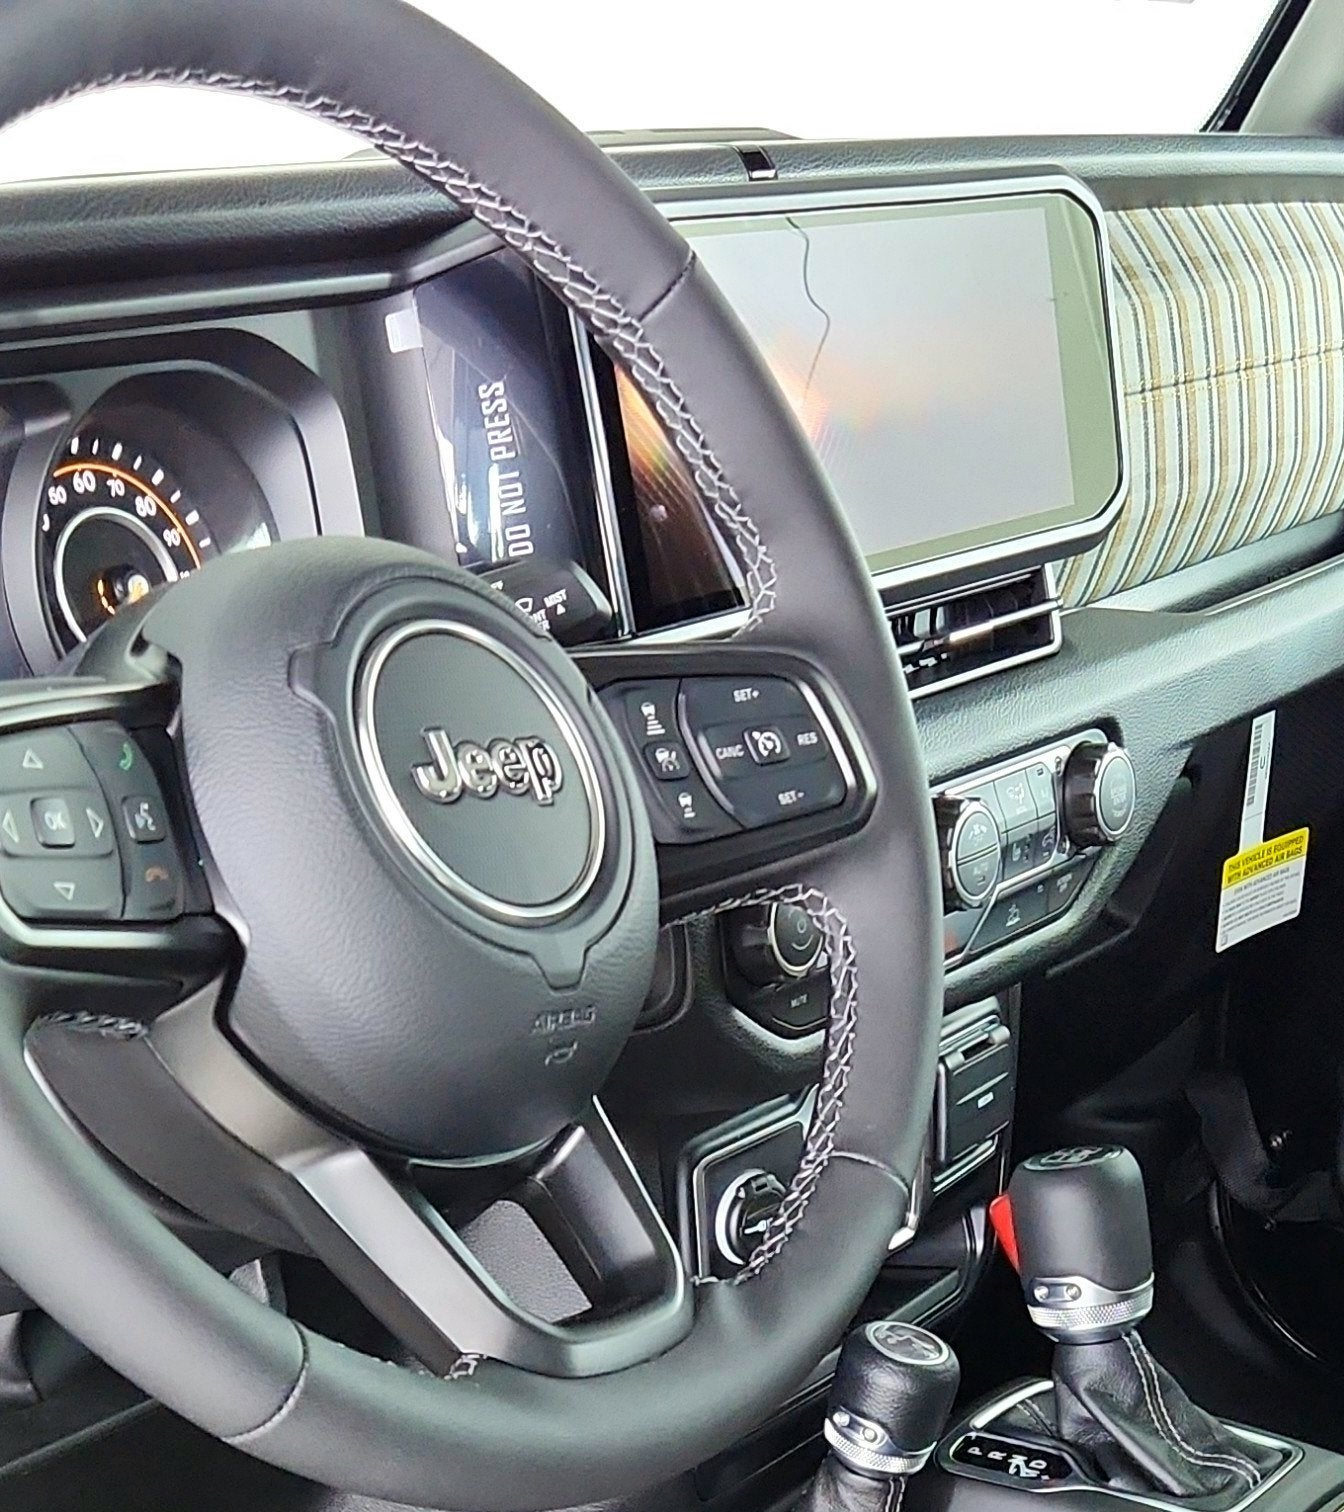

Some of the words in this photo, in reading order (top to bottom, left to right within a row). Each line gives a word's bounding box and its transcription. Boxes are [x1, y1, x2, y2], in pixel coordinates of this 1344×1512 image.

[478, 381, 517, 461] PRESS
[72, 470, 96, 494] 60
[106, 478, 125, 497] 70
[498, 470, 527, 516] NOT
[134, 495, 157, 517] 80
[162, 528, 181, 547] 90
[505, 524, 534, 558] DO
[797, 731, 818, 746] RES
[716, 744, 745, 759] CANC
[413, 727, 563, 806] Jeep
[44, 811, 66, 831] OK
[987, 1450, 1007, 1460] R
[1028, 1459, 1047, 1469] D
